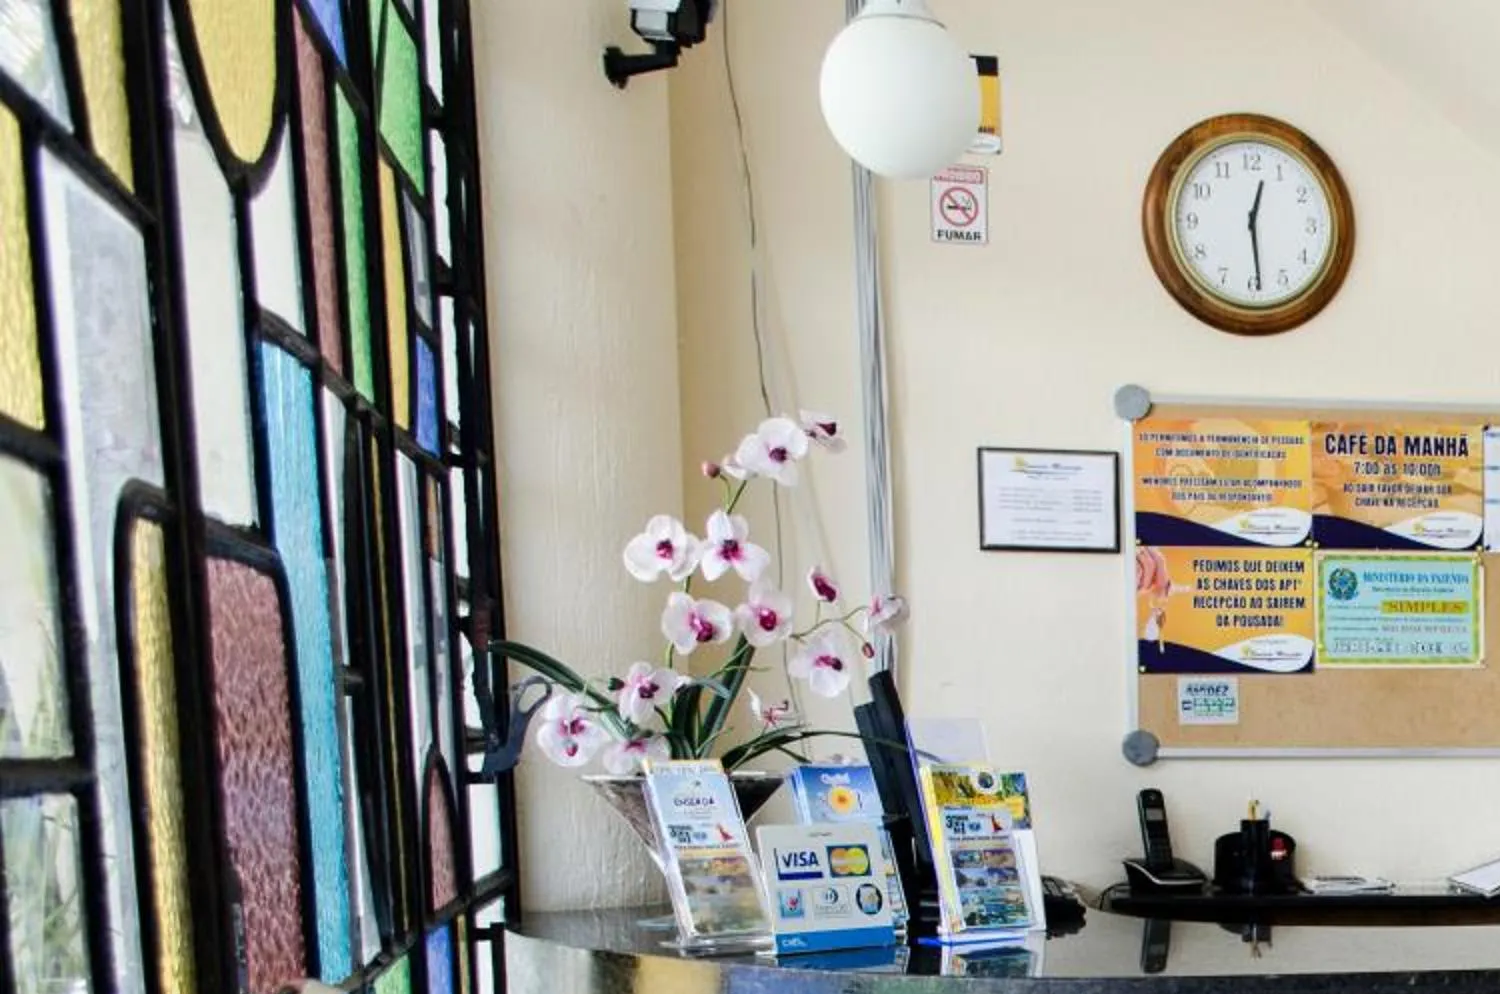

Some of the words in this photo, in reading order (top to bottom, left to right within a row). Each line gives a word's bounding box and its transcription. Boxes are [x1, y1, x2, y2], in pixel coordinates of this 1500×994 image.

[1215, 161, 1231, 179] 11
[1242, 152, 1262, 171] 12
[1275, 163, 1284, 182] 1
[1193, 182, 1211, 200] 10
[1296, 186, 1308, 203] 2
[1186, 211, 1199, 230] 9
[1305, 217, 1317, 235] 3
[937, 229, 982, 241] FUMAR
[1194, 243, 1207, 260] 8
[1297, 247, 1308, 265] 4
[1218, 266, 1229, 285] 7
[1277, 269, 1289, 286] 5
[1375, 435, 1397, 456] DA
[1403, 433, 1469, 457] MANHÃ
[1354, 461, 1380, 475] 7:00
[1193, 559, 1240, 573] PEDIMOS
[1243, 560, 1262, 573] QUE
[1265, 560, 1305, 574] DEIXEM
[1196, 577, 1210, 591] AS
[1213, 577, 1251, 591] CHAVES
[1255, 578, 1275, 591] DOS
[1250, 597, 1263, 610] AO
[1266, 597, 1305, 610] SAIREM
[1216, 615, 1230, 627] DA
[782, 851, 820, 868] VISA
